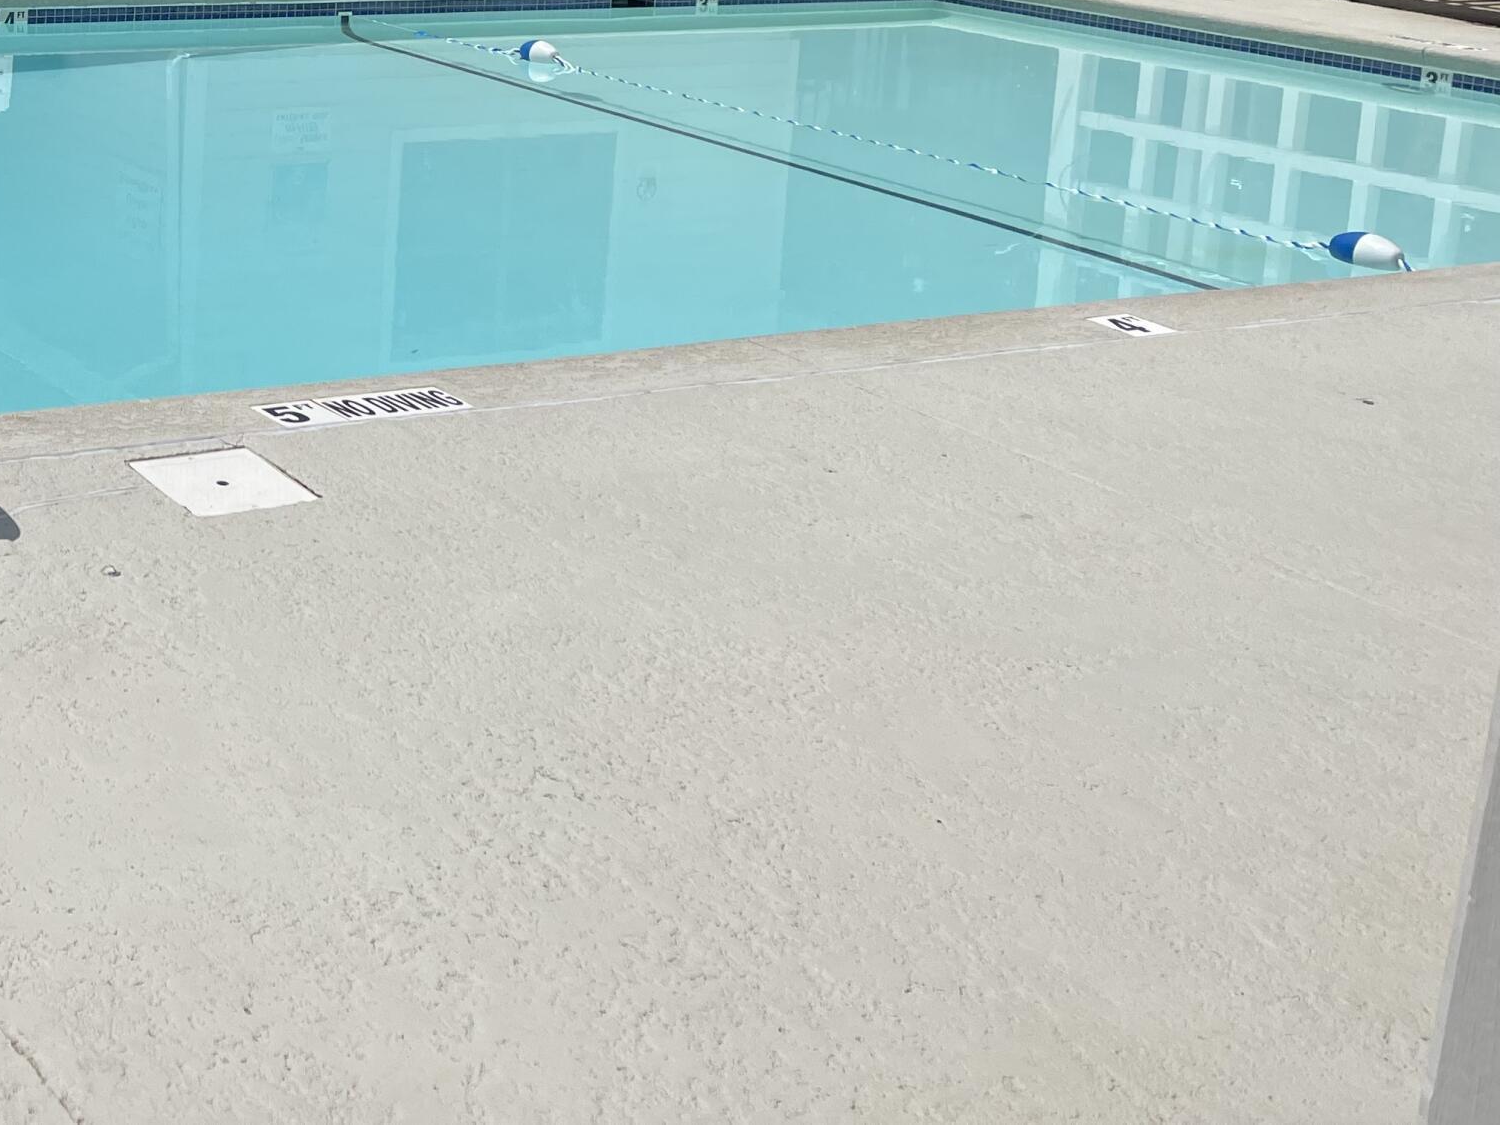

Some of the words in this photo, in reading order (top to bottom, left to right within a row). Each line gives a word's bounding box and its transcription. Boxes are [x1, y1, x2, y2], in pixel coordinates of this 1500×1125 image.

[1107, 318, 1151, 333] 4
[262, 405, 311, 424] 5
[323, 399, 376, 418] NO
[363, 390, 464, 414] DIVING
